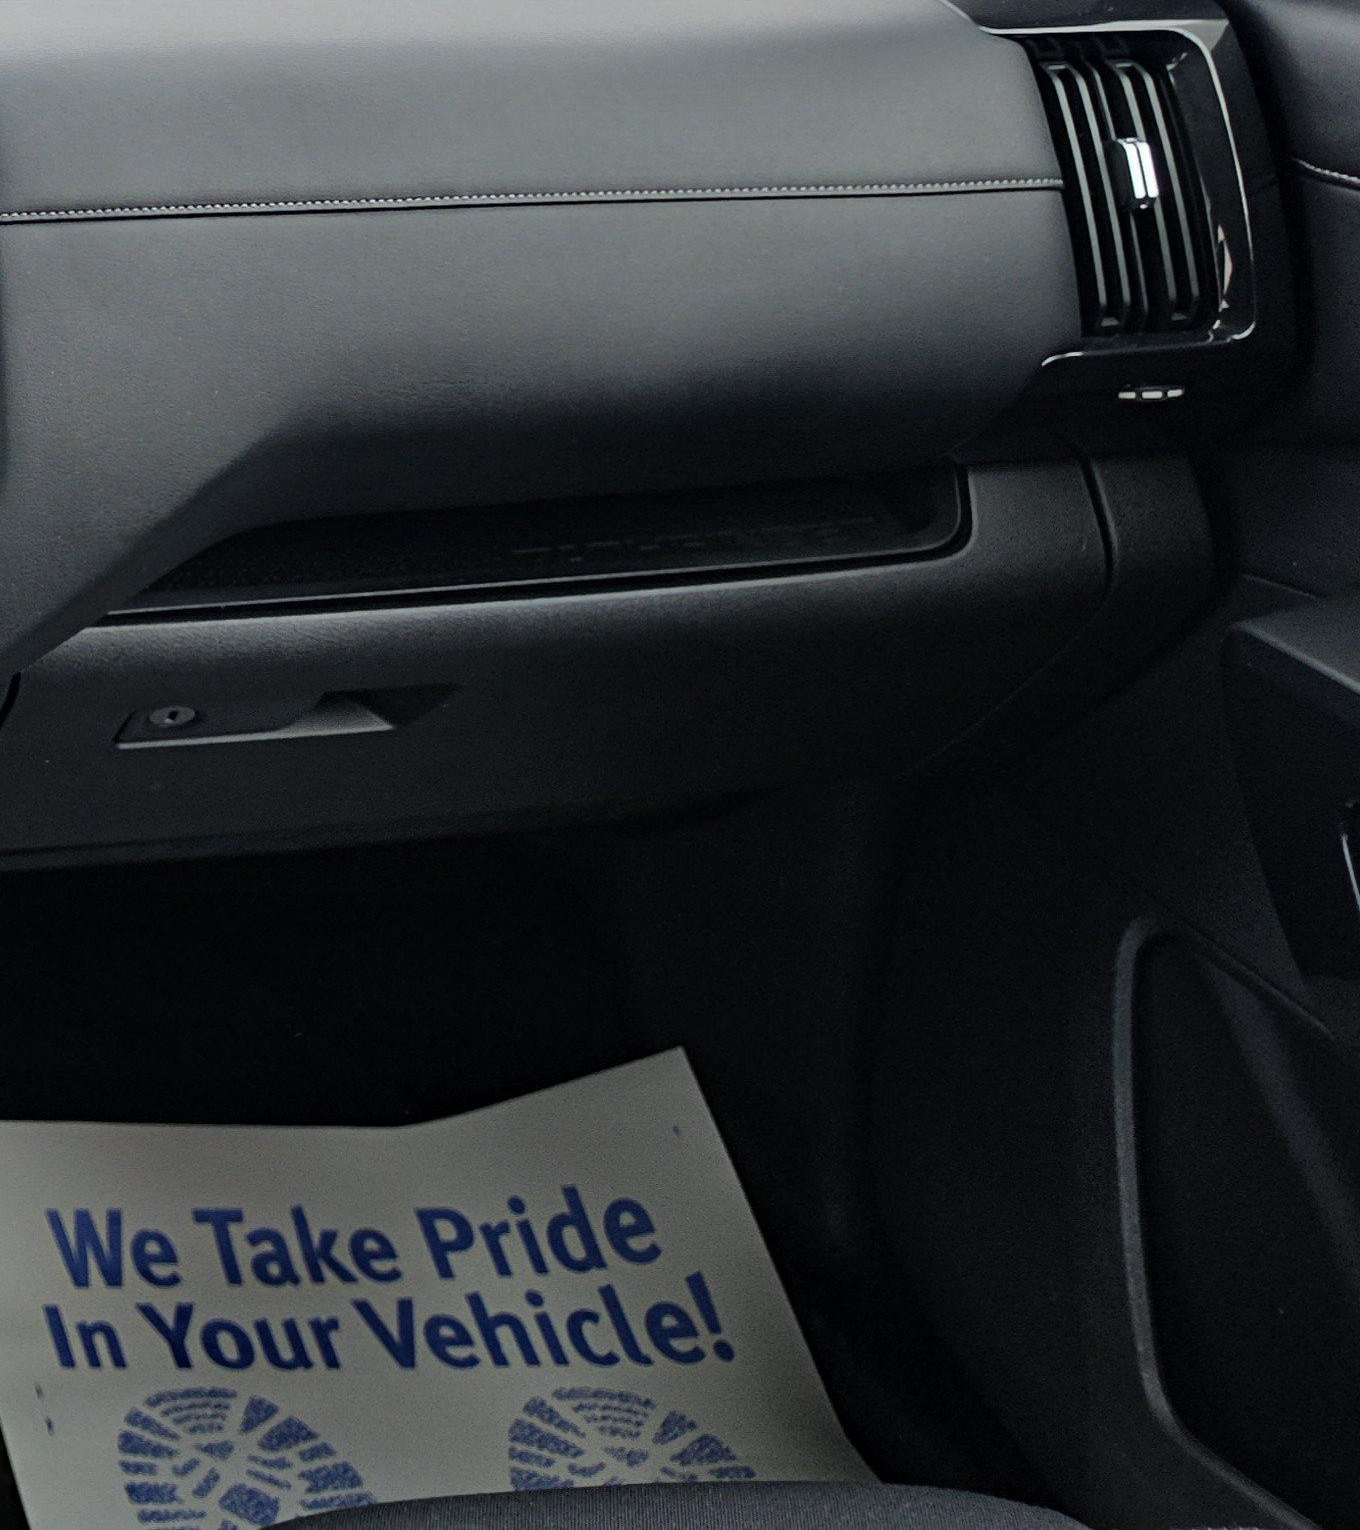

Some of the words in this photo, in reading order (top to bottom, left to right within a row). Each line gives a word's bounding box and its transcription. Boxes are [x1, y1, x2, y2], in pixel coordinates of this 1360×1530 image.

[47, 1208, 179, 1288] We
[193, 1205, 400, 1286] Take
[415, 1185, 662, 1275] Pride
[43, 1305, 128, 1369] In
[136, 1302, 342, 1371] Your
[353, 1272, 736, 1369] Vehicle!
